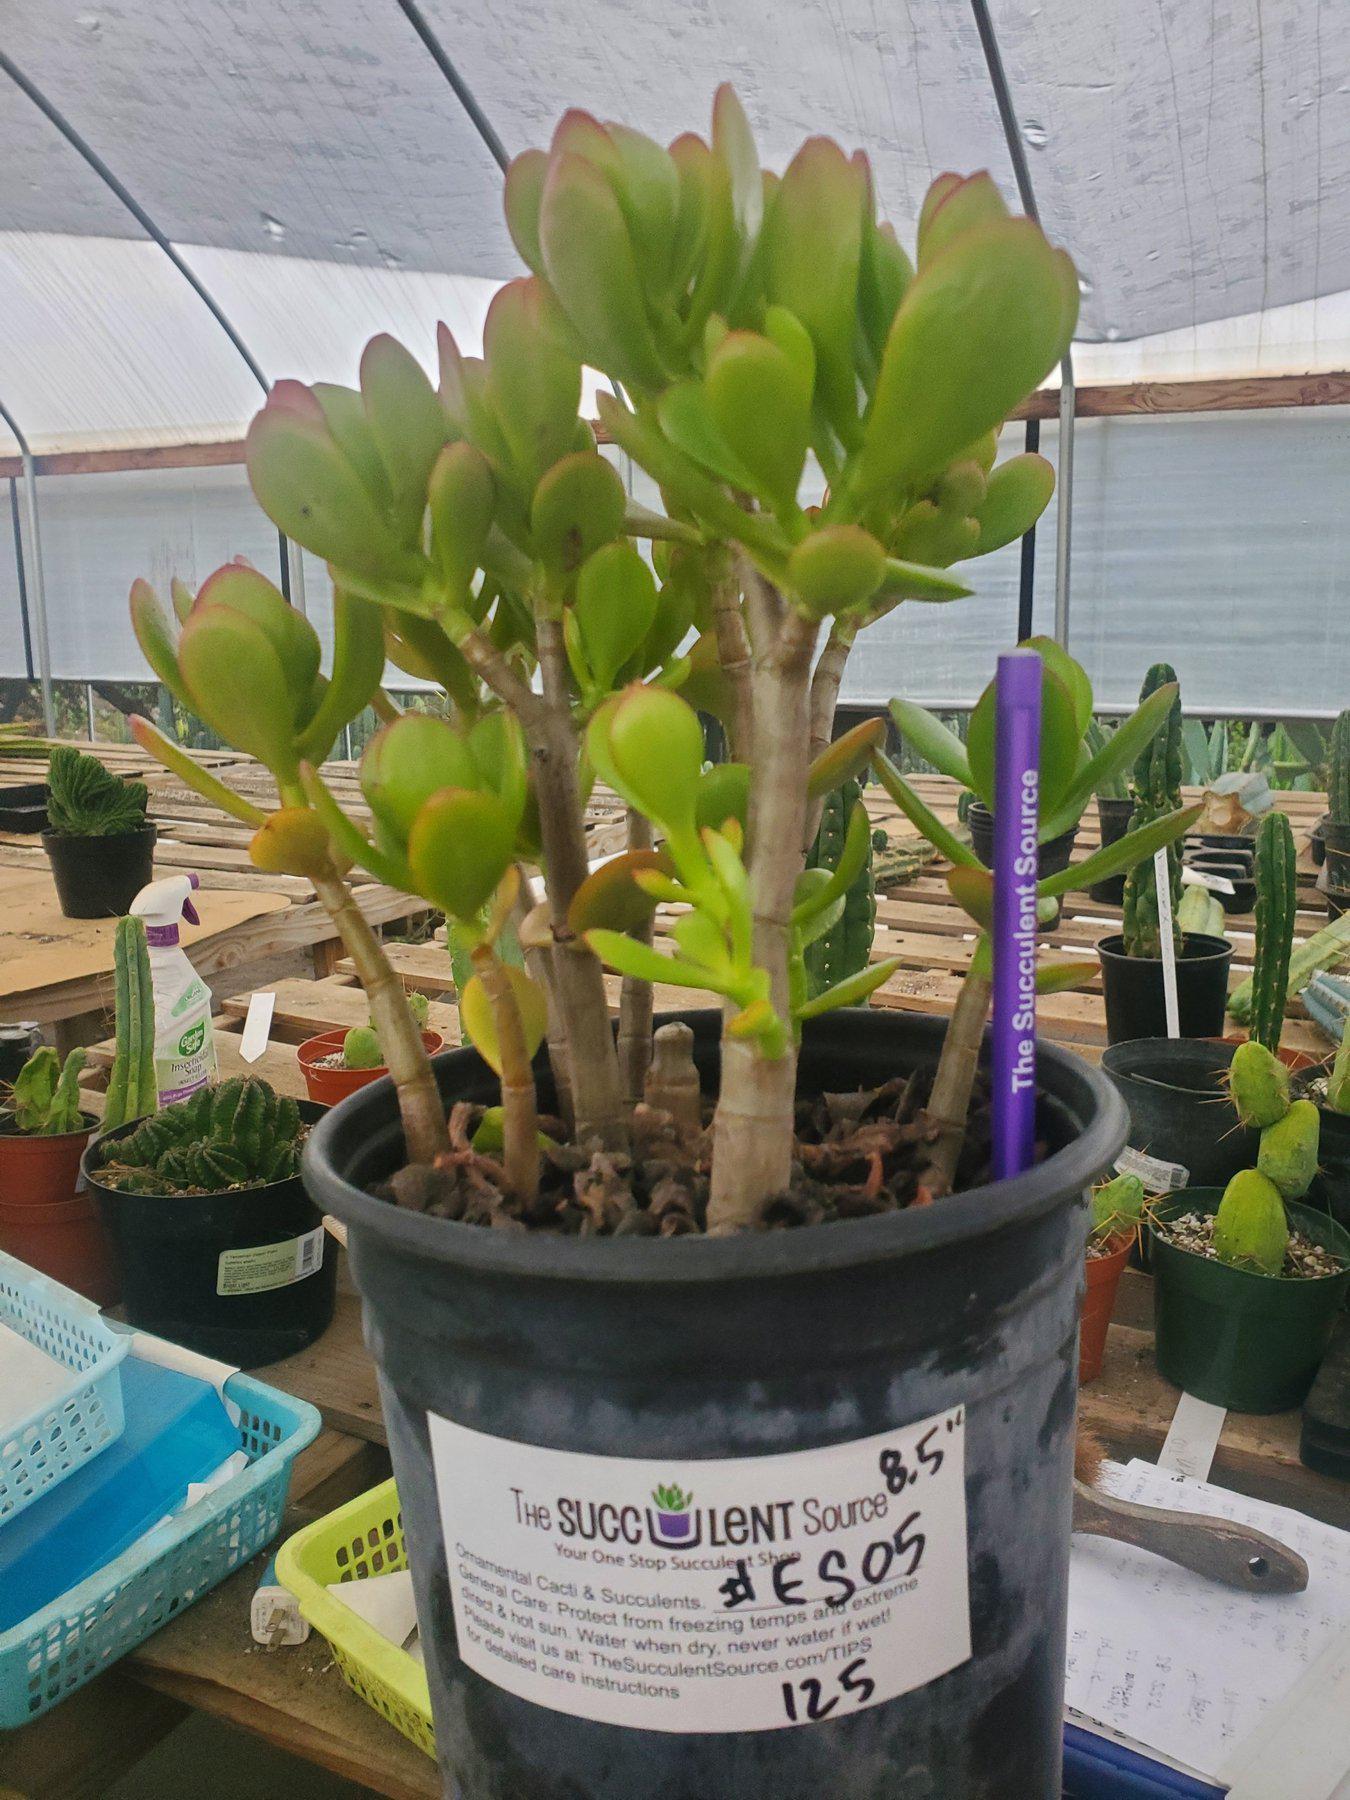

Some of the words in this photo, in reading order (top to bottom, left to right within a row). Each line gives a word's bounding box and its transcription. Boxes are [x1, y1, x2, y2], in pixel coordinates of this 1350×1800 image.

[1014, 768, 1039, 876] Source
[1012, 880, 1036, 1031] Succulent
[1011, 1038, 1034, 1094] The
[802, 1492, 888, 1535] Source
[456, 1541, 532, 1586] Ornamental
[536, 1575, 578, 1598] Cacti
[583, 1585, 596, 1601] &
[554, 1542, 587, 1561] Your
[592, 1549, 625, 1566] One
[629, 1553, 667, 1571] Stop
[459, 1563, 507, 1599] General
[557, 1602, 617, 1626] Protect
[624, 1612, 663, 1631] from
[669, 1615, 744, 1635] freezing
[750, 1610, 807, 1630] temps
[852, 1576, 919, 1611] extreme
[462, 1586, 493, 1613] direct
[498, 1603, 507, 1620] &
[510, 1609, 535, 1630] hot
[576, 1626, 627, 1649] Water
[634, 1637, 682, 1654] when
[728, 1636, 779, 1654] never
[786, 1625, 836, 1647] water
[841, 1620, 852, 1637] if
[856, 1607, 891, 1632] wet!
[464, 1603, 505, 1639] Please
[508, 1631, 537, 1652] visit
[540, 1643, 560, 1659] us
[589, 1636, 872, 1678] TheSucculentSource.com/TIPS
[465, 1625, 481, 1644] for
[484, 1638, 538, 1673] detailed
[541, 1663, 577, 1684] care
[581, 1672, 681, 1700] instructions
[782, 1658, 876, 1722] 125
